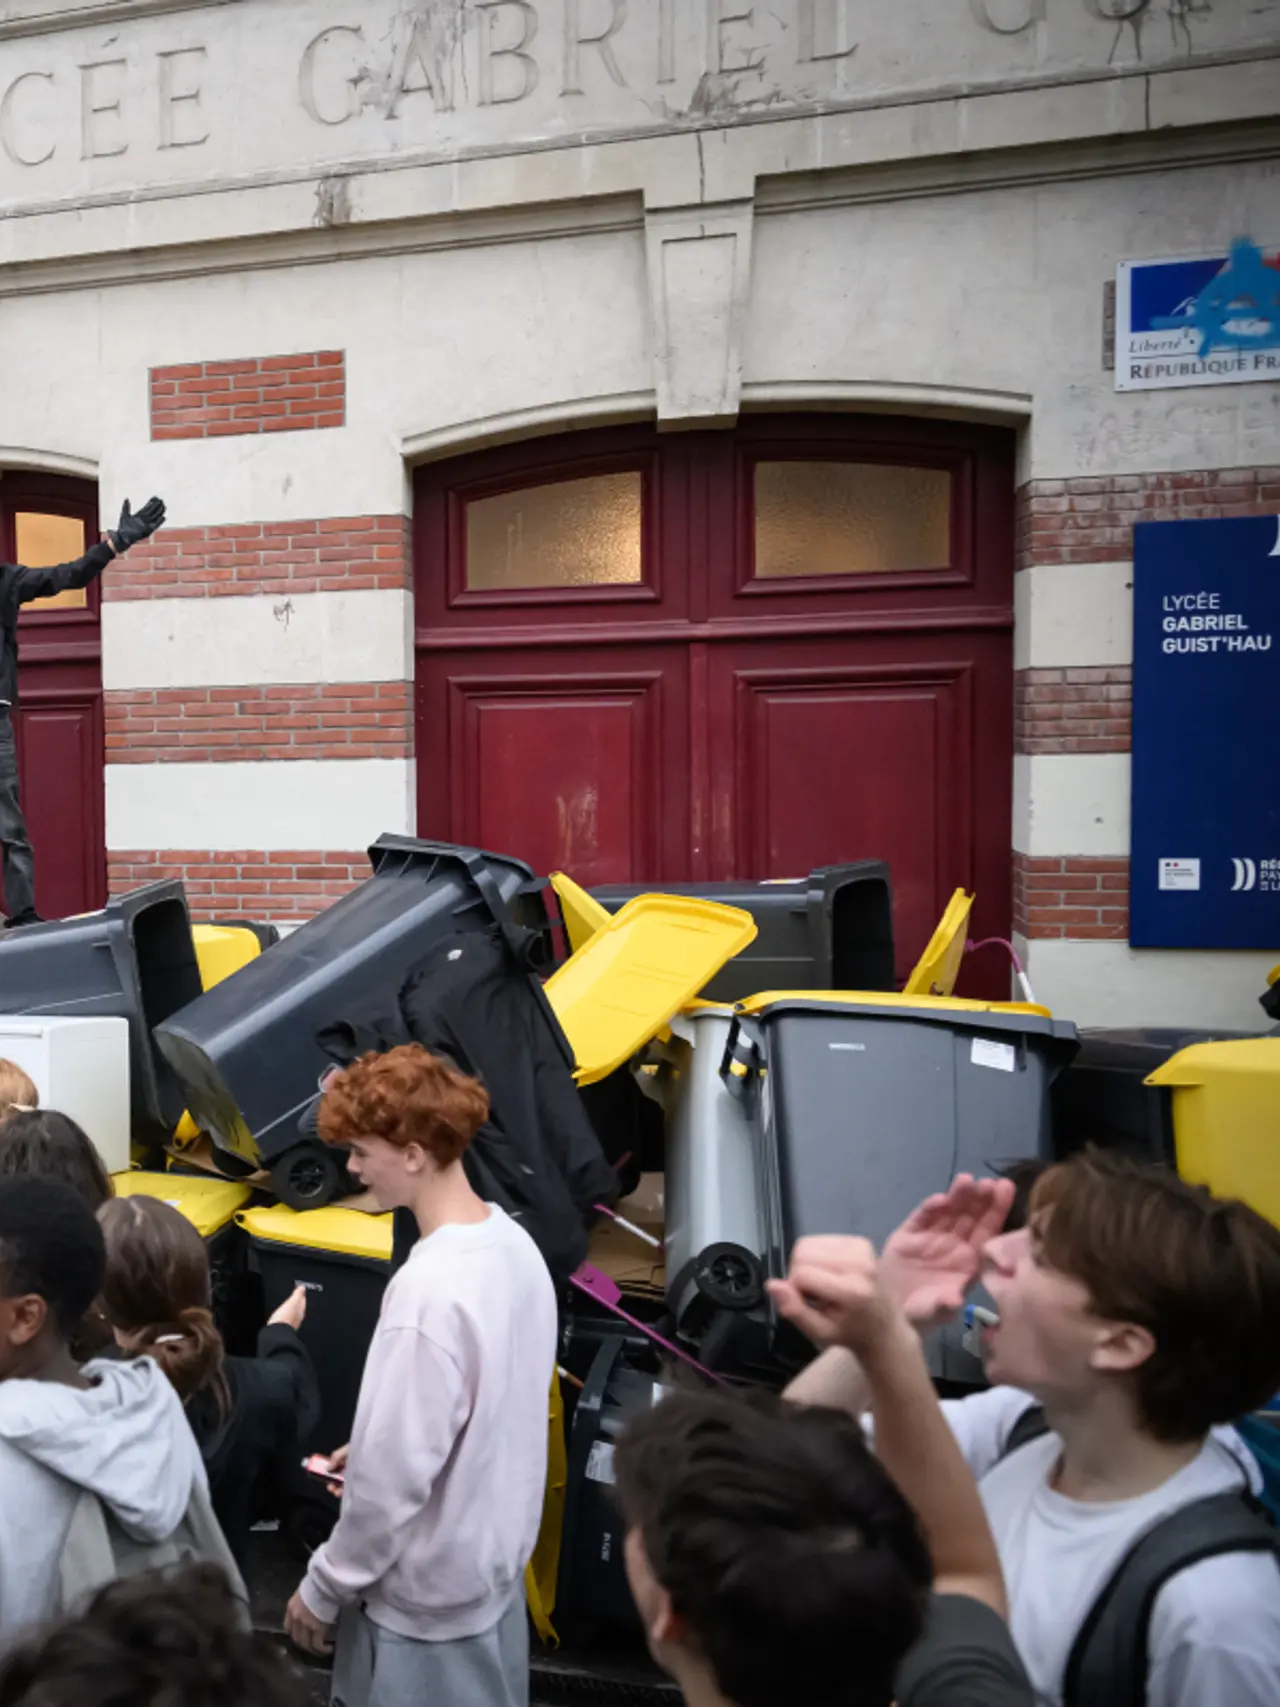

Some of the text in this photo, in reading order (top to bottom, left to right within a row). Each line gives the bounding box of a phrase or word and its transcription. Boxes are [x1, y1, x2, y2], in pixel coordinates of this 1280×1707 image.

[1130, 357, 1248, 380] RÉPUBLIQUE
[1162, 590, 1221, 611] LYCÉE
[1162, 614, 1249, 632] GABRIEL
[1162, 634, 1272, 654] GUIST'HAU
